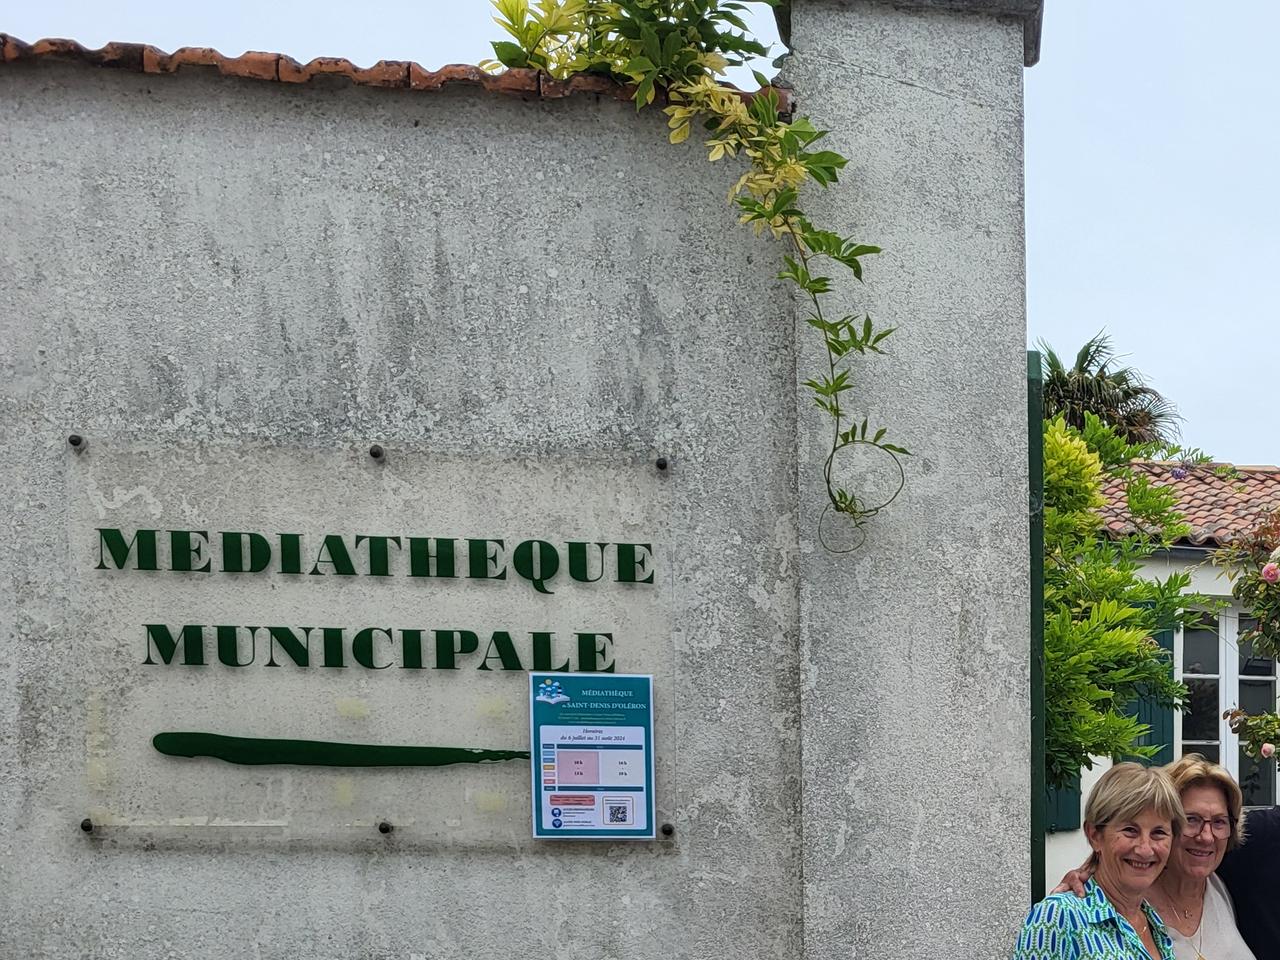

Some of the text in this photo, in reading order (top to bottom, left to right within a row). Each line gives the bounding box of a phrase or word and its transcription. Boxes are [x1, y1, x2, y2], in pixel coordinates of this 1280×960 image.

[94, 527, 656, 594] MEDIATHEQUE
[140, 623, 617, 673] MUNICIPALE
[581, 689, 633, 698] MÉDIATHÈQUE
[612, 702, 647, 710] D'OLÉRON
